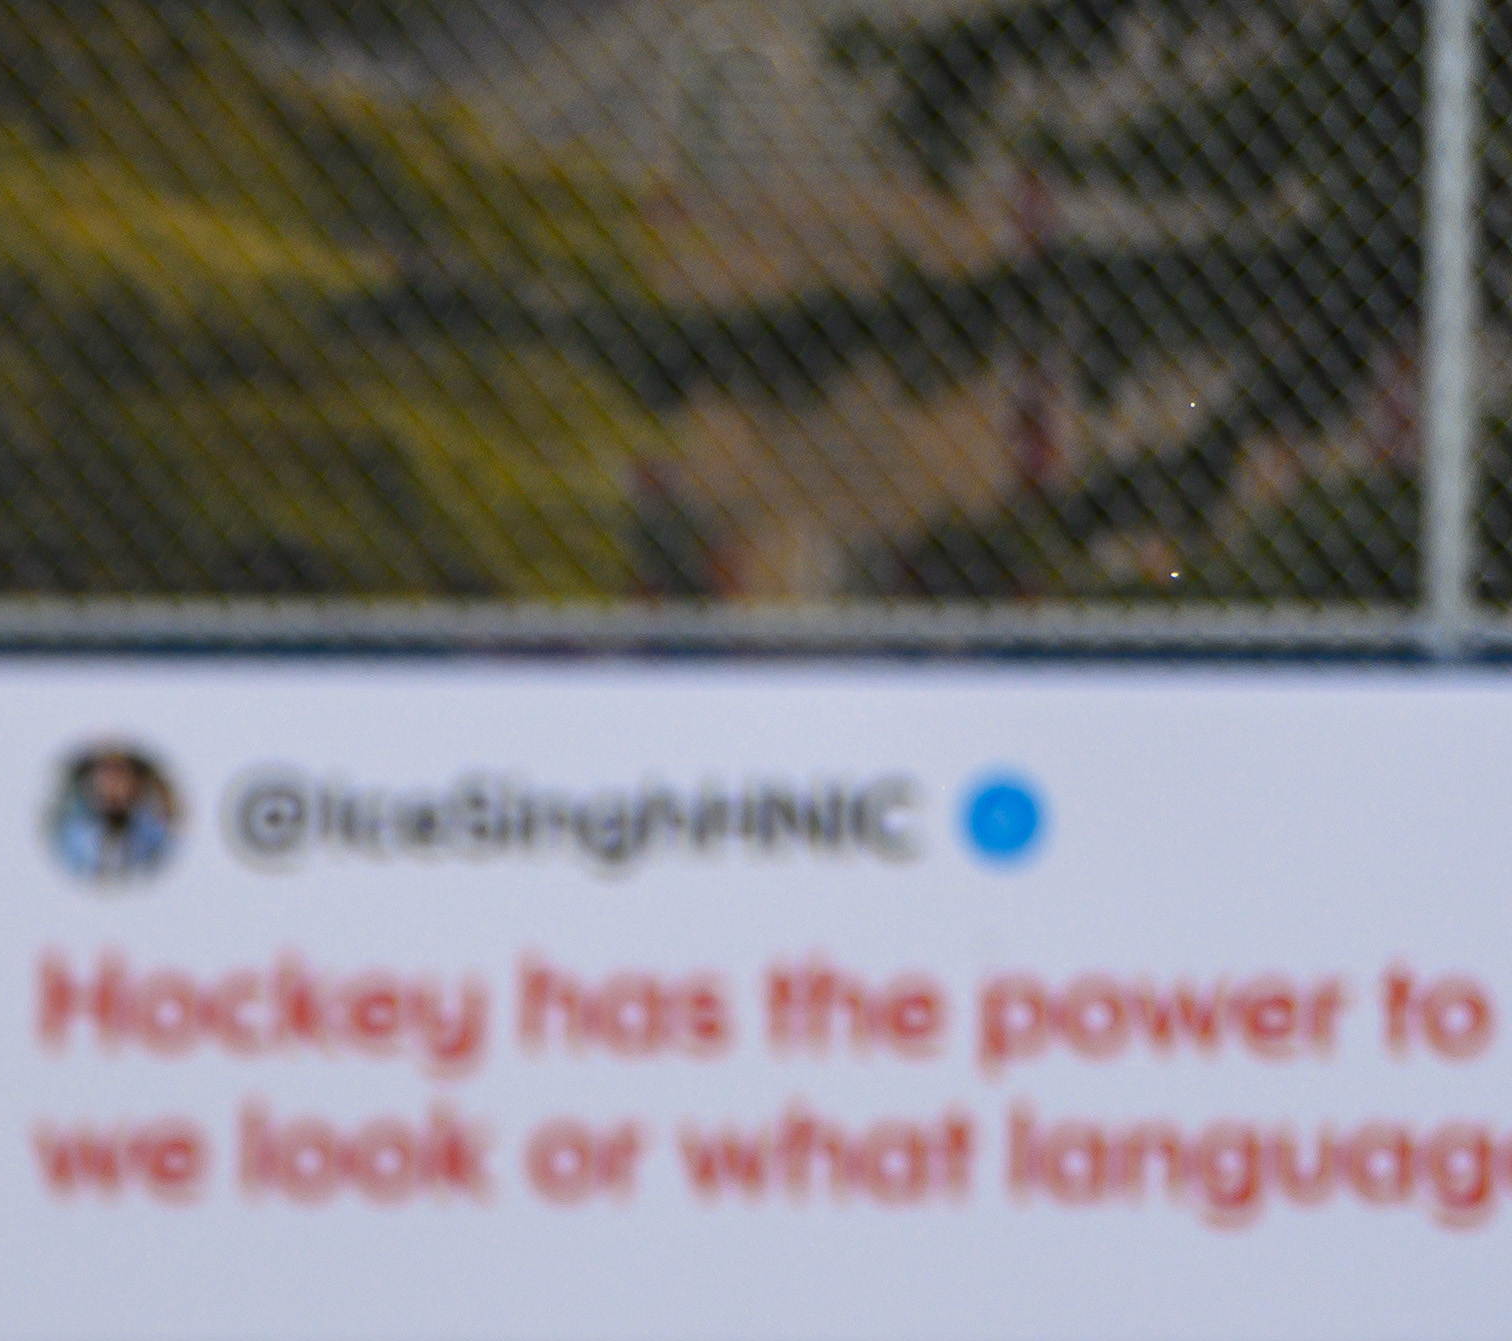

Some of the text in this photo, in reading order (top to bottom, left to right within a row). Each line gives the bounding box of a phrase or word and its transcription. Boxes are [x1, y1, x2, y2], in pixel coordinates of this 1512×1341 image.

[36, 948, 1494, 1083] Hockey has the power to
[34, 1098, 1512, 1232] we look or what languag
